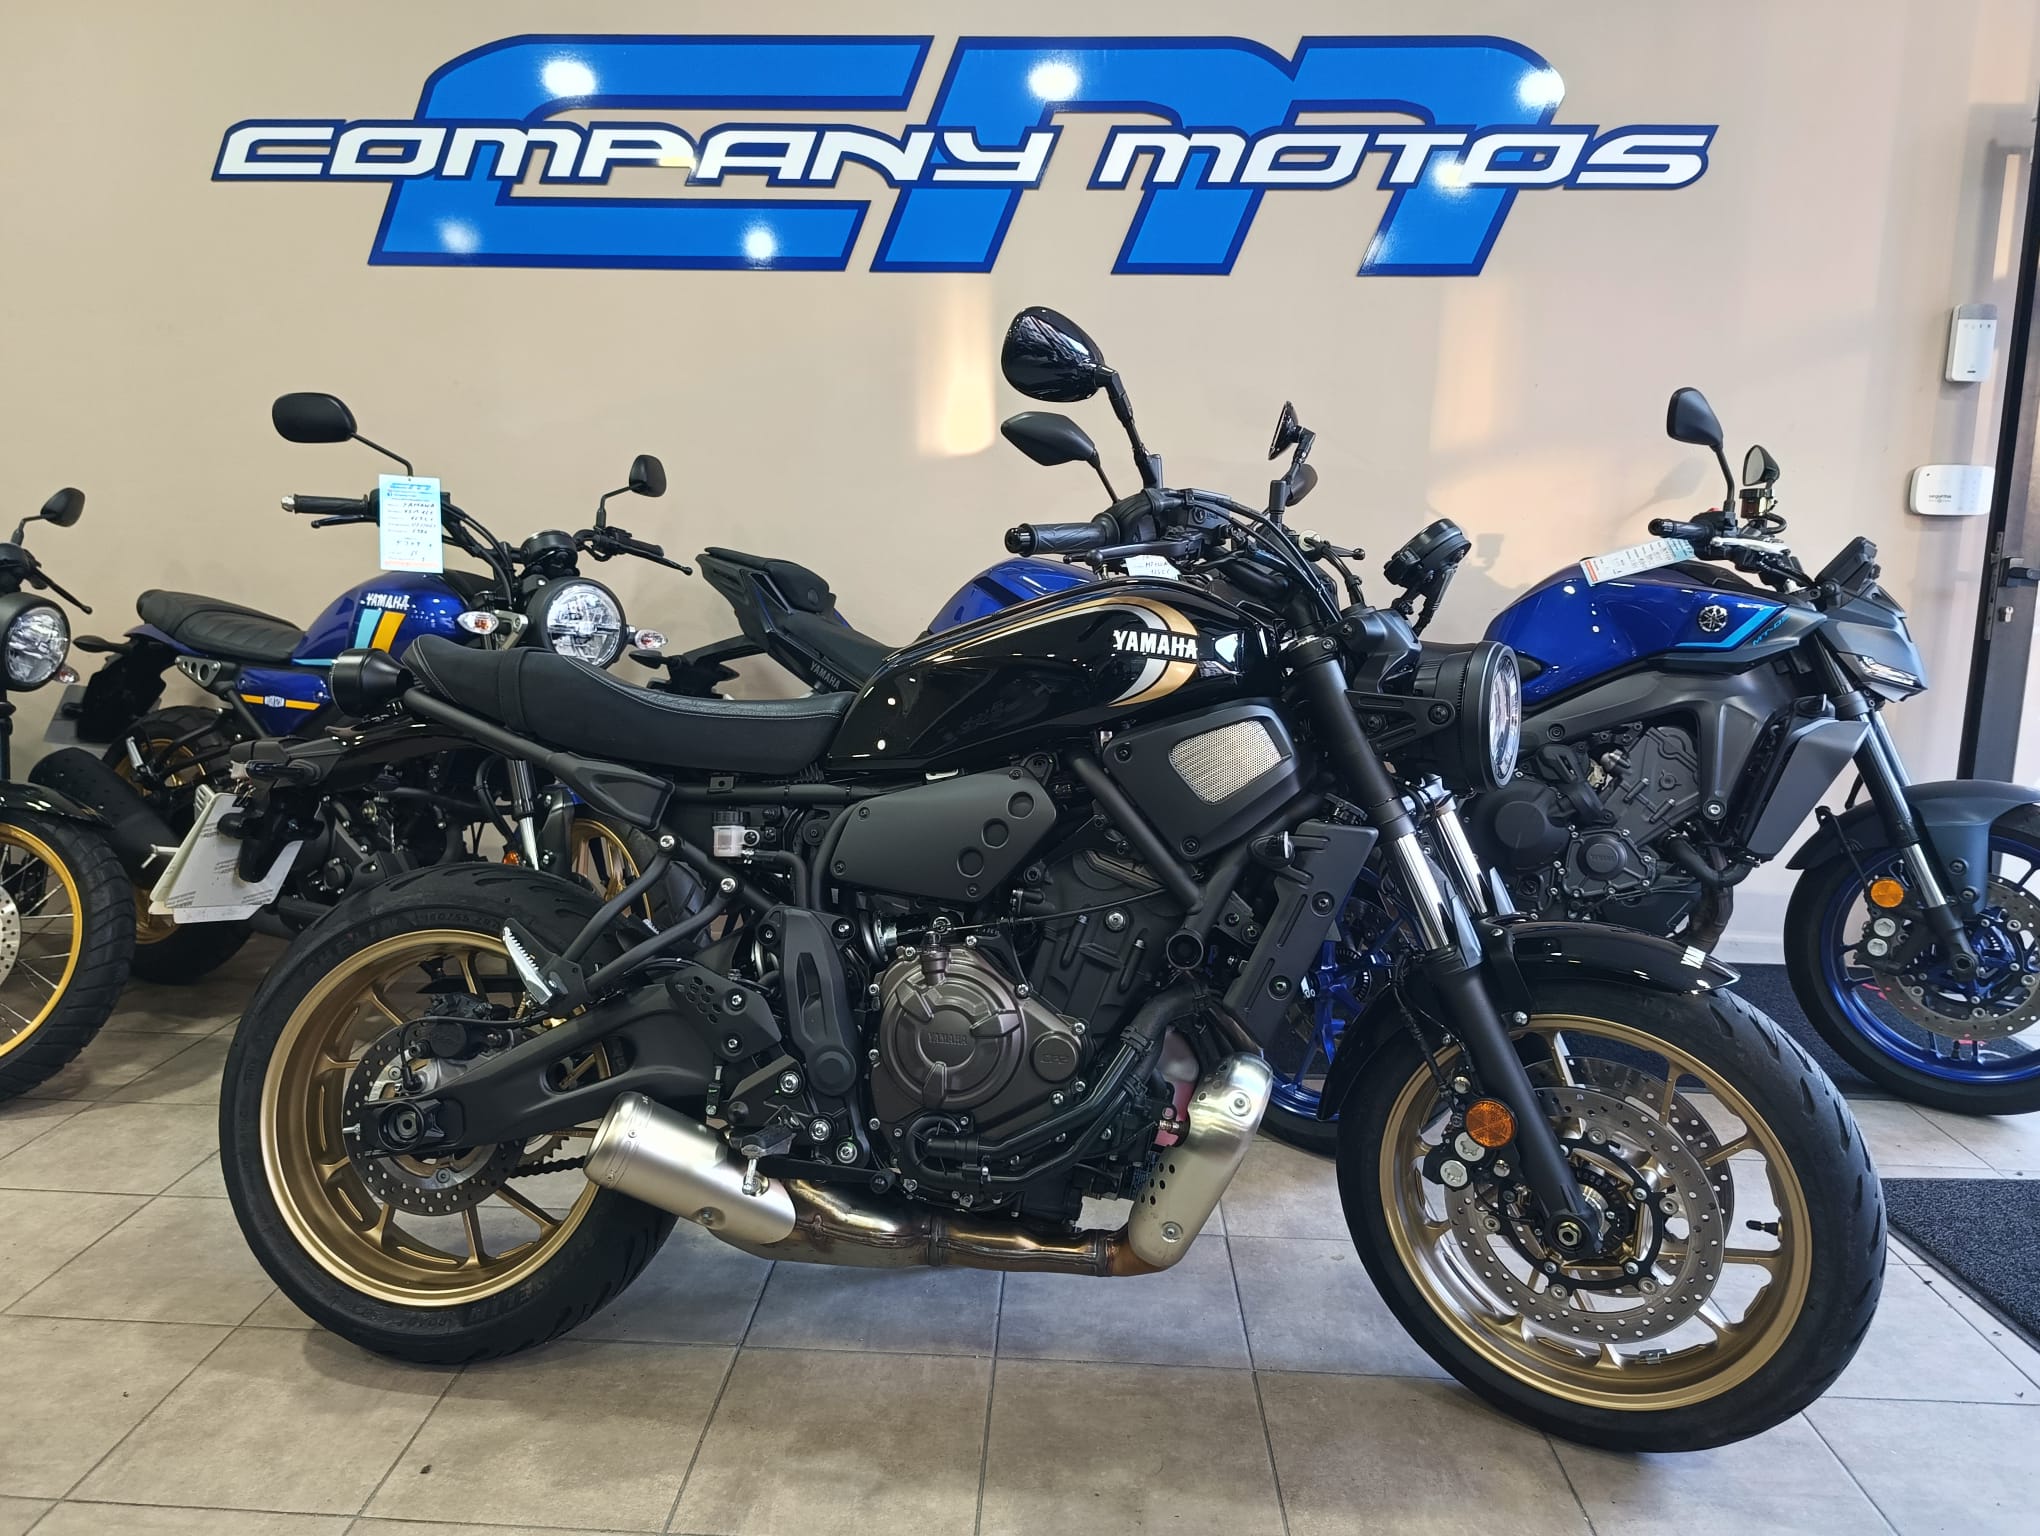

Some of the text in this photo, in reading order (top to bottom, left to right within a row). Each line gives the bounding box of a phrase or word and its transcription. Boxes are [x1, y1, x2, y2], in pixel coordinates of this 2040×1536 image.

[214, 122, 1716, 189] COMPANY MOTOS
[366, 592, 410, 611] YAMAHA
[1113, 629, 1198, 660] YAMAHA
[810, 660, 841, 690] YAMAHA
[927, 1031, 968, 1046] YAMAHA
